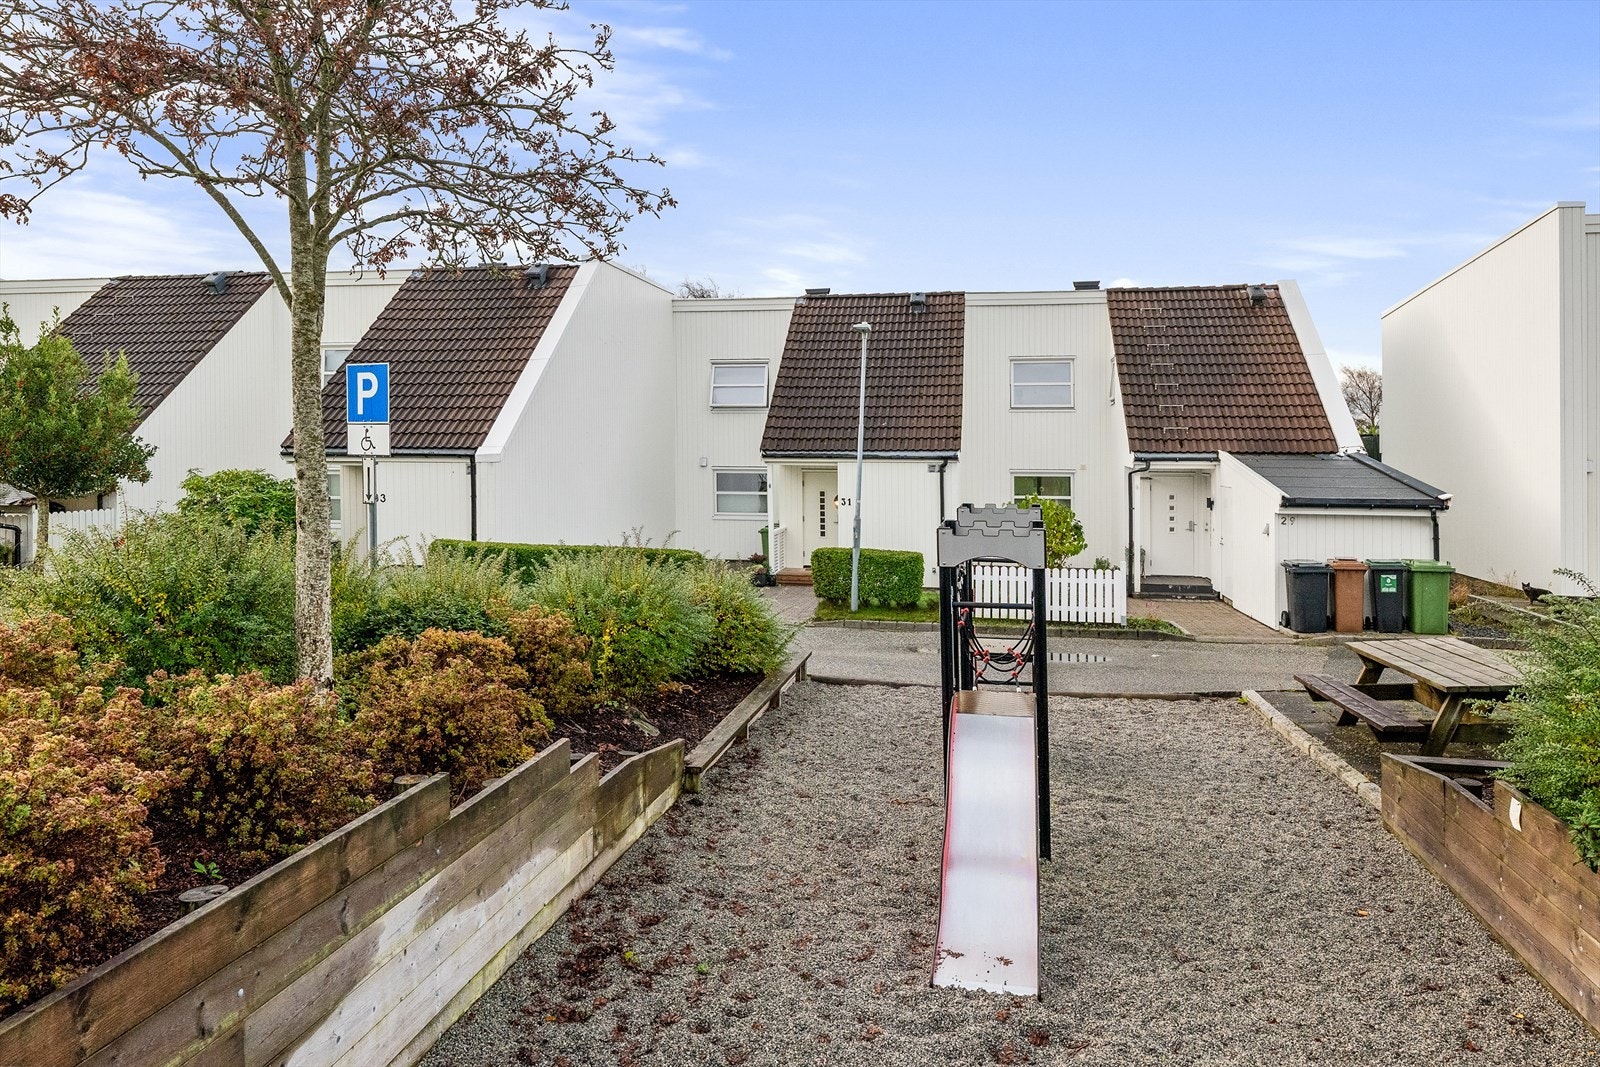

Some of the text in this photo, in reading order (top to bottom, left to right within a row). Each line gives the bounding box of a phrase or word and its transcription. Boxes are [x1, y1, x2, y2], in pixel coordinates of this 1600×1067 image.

[357, 372, 378, 415] P
[841, 497, 851, 506] 31
[1280, 516, 1296, 526] 29
